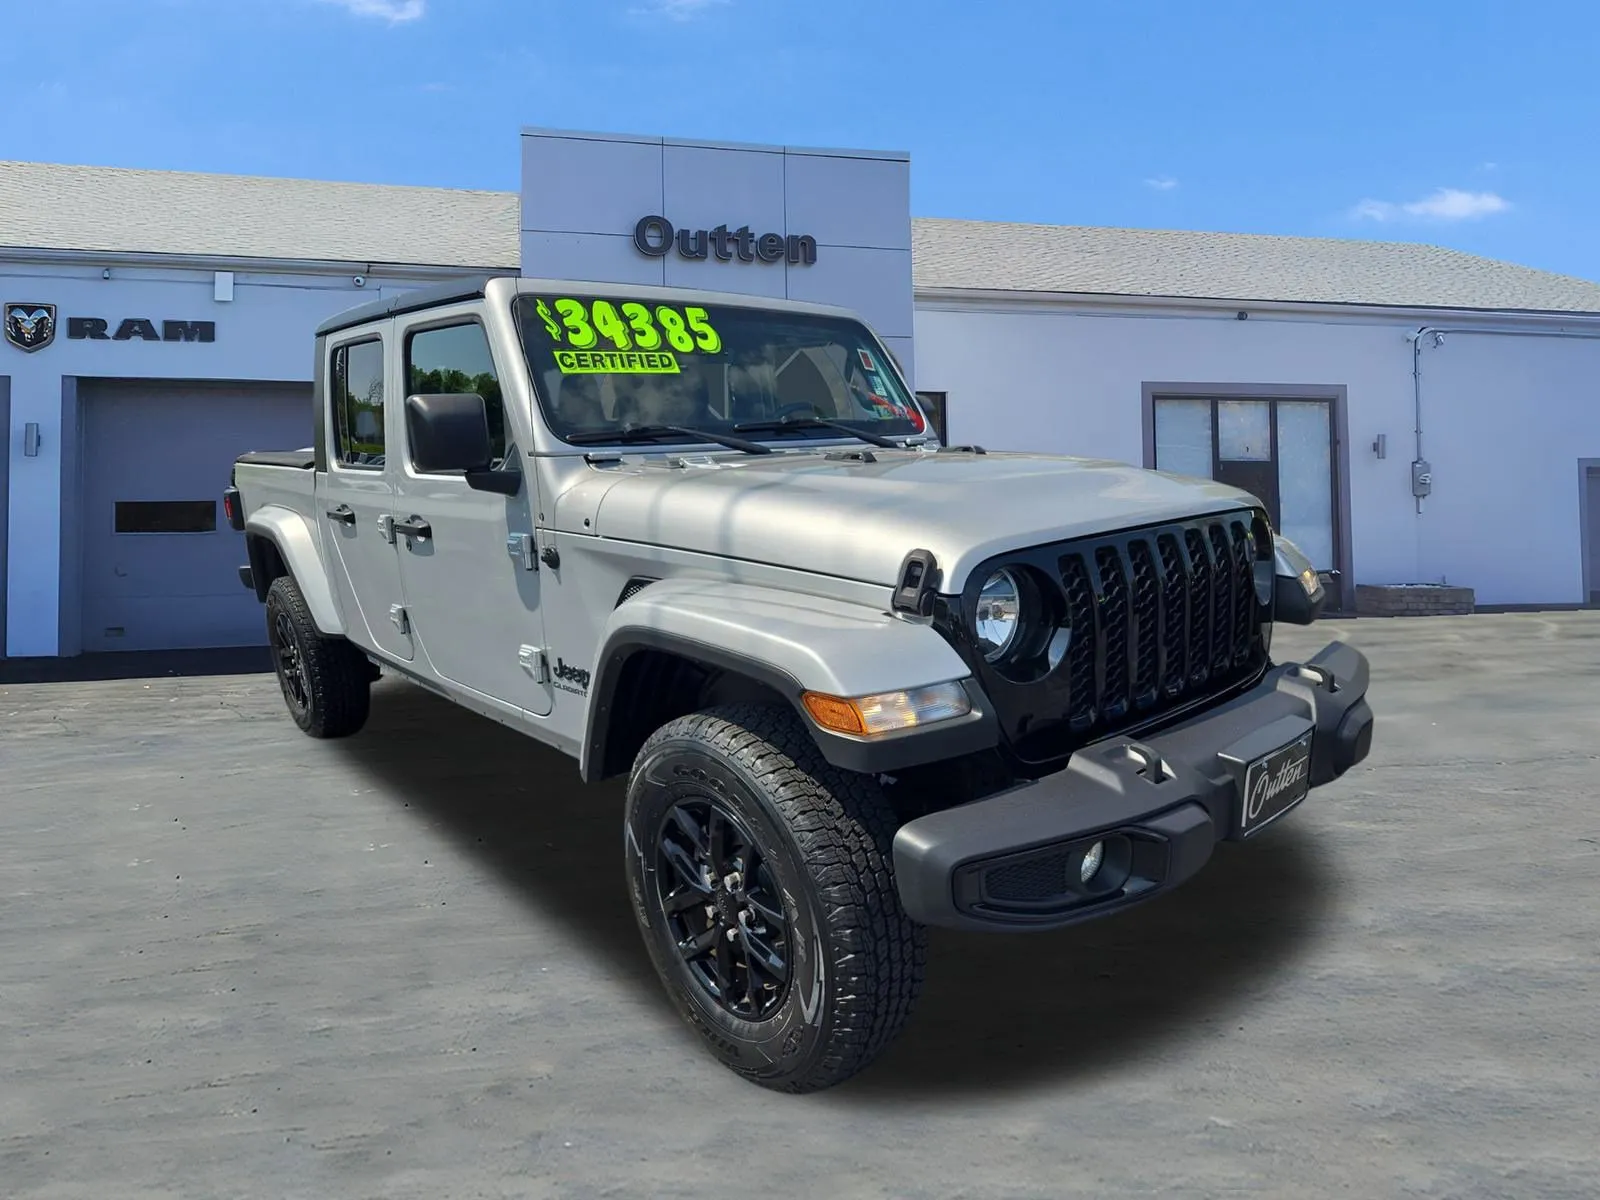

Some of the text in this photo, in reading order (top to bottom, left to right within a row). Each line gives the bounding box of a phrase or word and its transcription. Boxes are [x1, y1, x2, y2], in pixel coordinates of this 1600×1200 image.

[634, 214, 818, 264] Outten
[67, 317, 215, 342] RAM
[536, 298, 722, 354] $34385
[558, 352, 673, 370] CERTIFIED
[553, 657, 591, 690] Jeep
[1248, 755, 1308, 819] Outten
